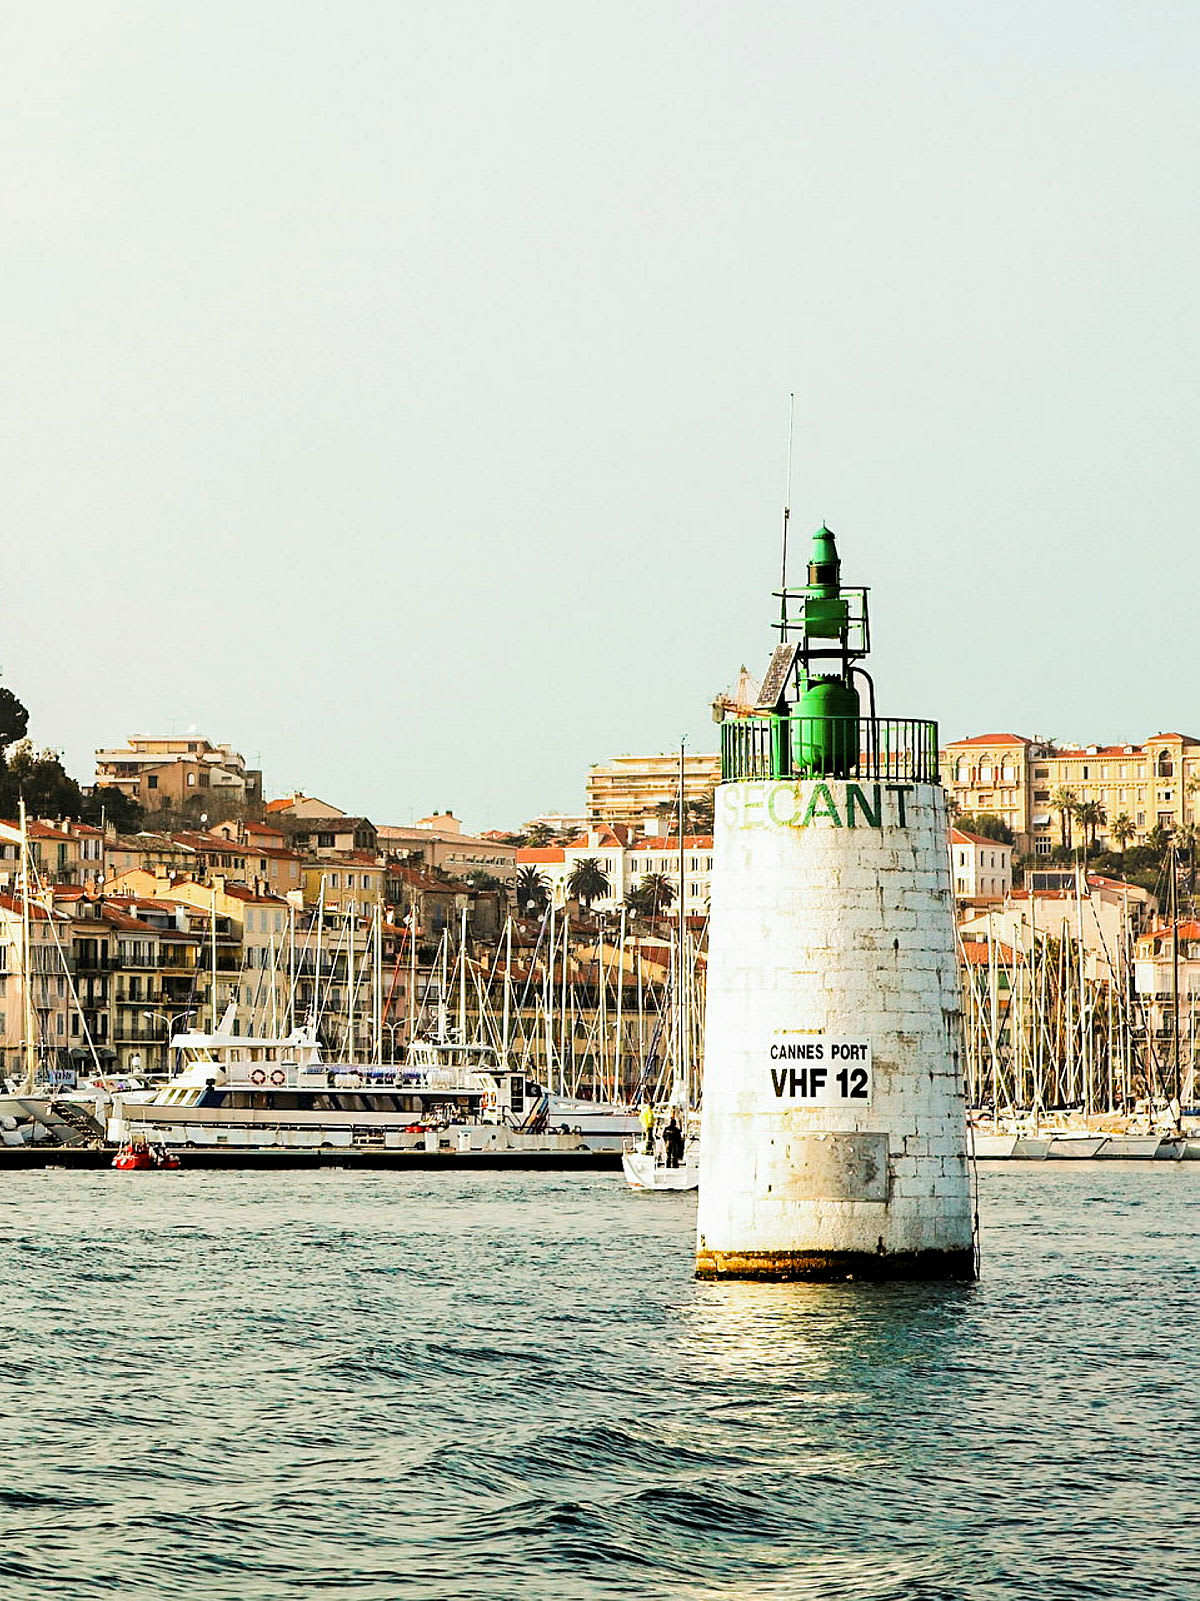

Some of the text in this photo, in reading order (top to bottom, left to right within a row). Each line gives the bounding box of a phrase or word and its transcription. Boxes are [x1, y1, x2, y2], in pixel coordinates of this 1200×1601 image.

[722, 783, 914, 829] SECANT
[770, 1044, 868, 1060] CANNES PORT
[770, 1067, 869, 1099] VHF 12
